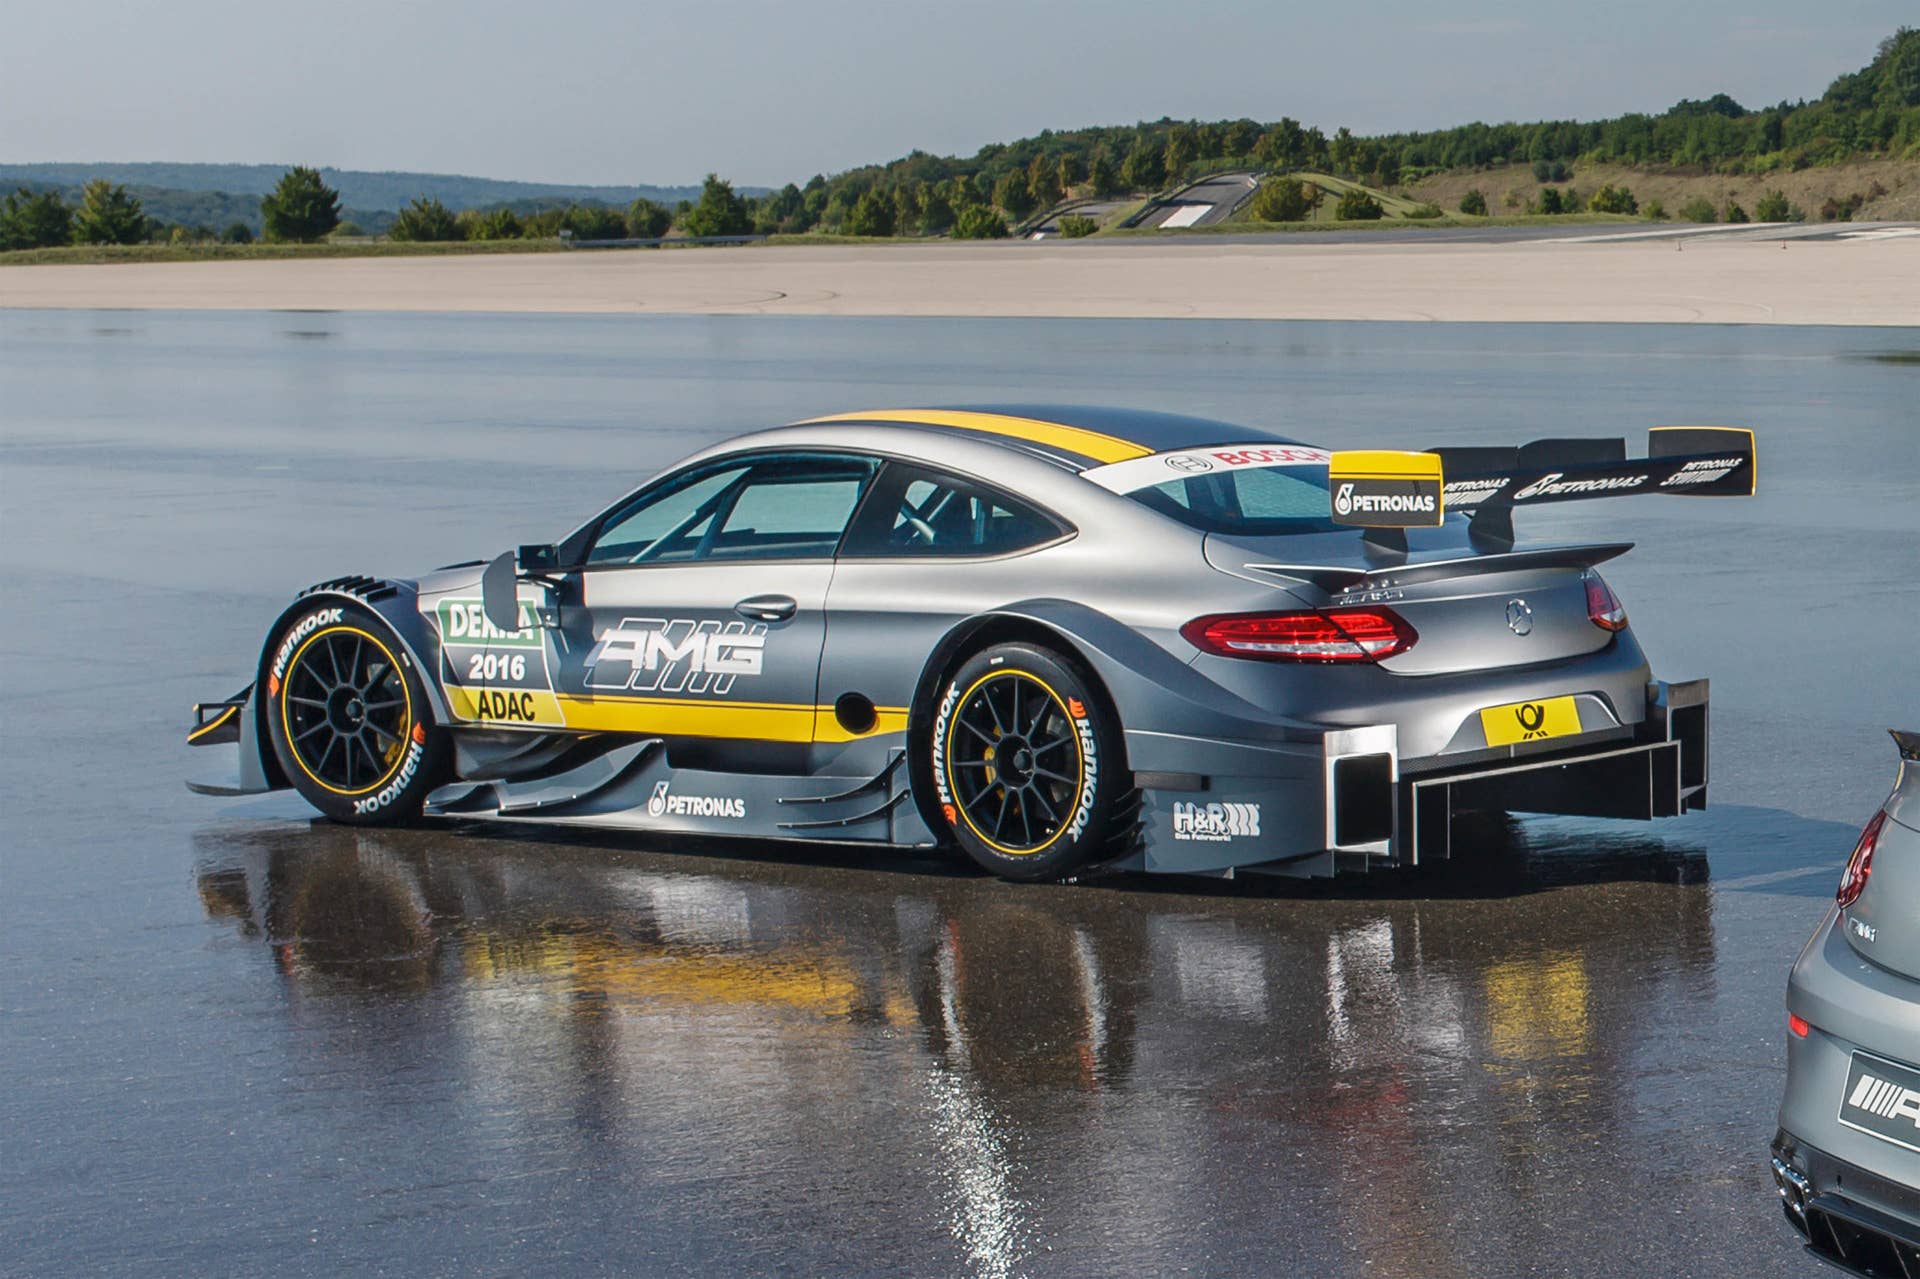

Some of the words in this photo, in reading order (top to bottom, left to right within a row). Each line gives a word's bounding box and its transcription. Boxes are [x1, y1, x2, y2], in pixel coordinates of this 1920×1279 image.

[1537, 475, 1649, 495] PETRONAS
[1353, 495, 1435, 512] PETRONAS
[450, 604, 534, 640] DEKA
[592, 628, 767, 675] AMG
[469, 654, 526, 681] 2016
[478, 690, 536, 721] ADAC
[666, 795, 745, 818] PETRONAS
[1174, 802, 1230, 835] H&R
